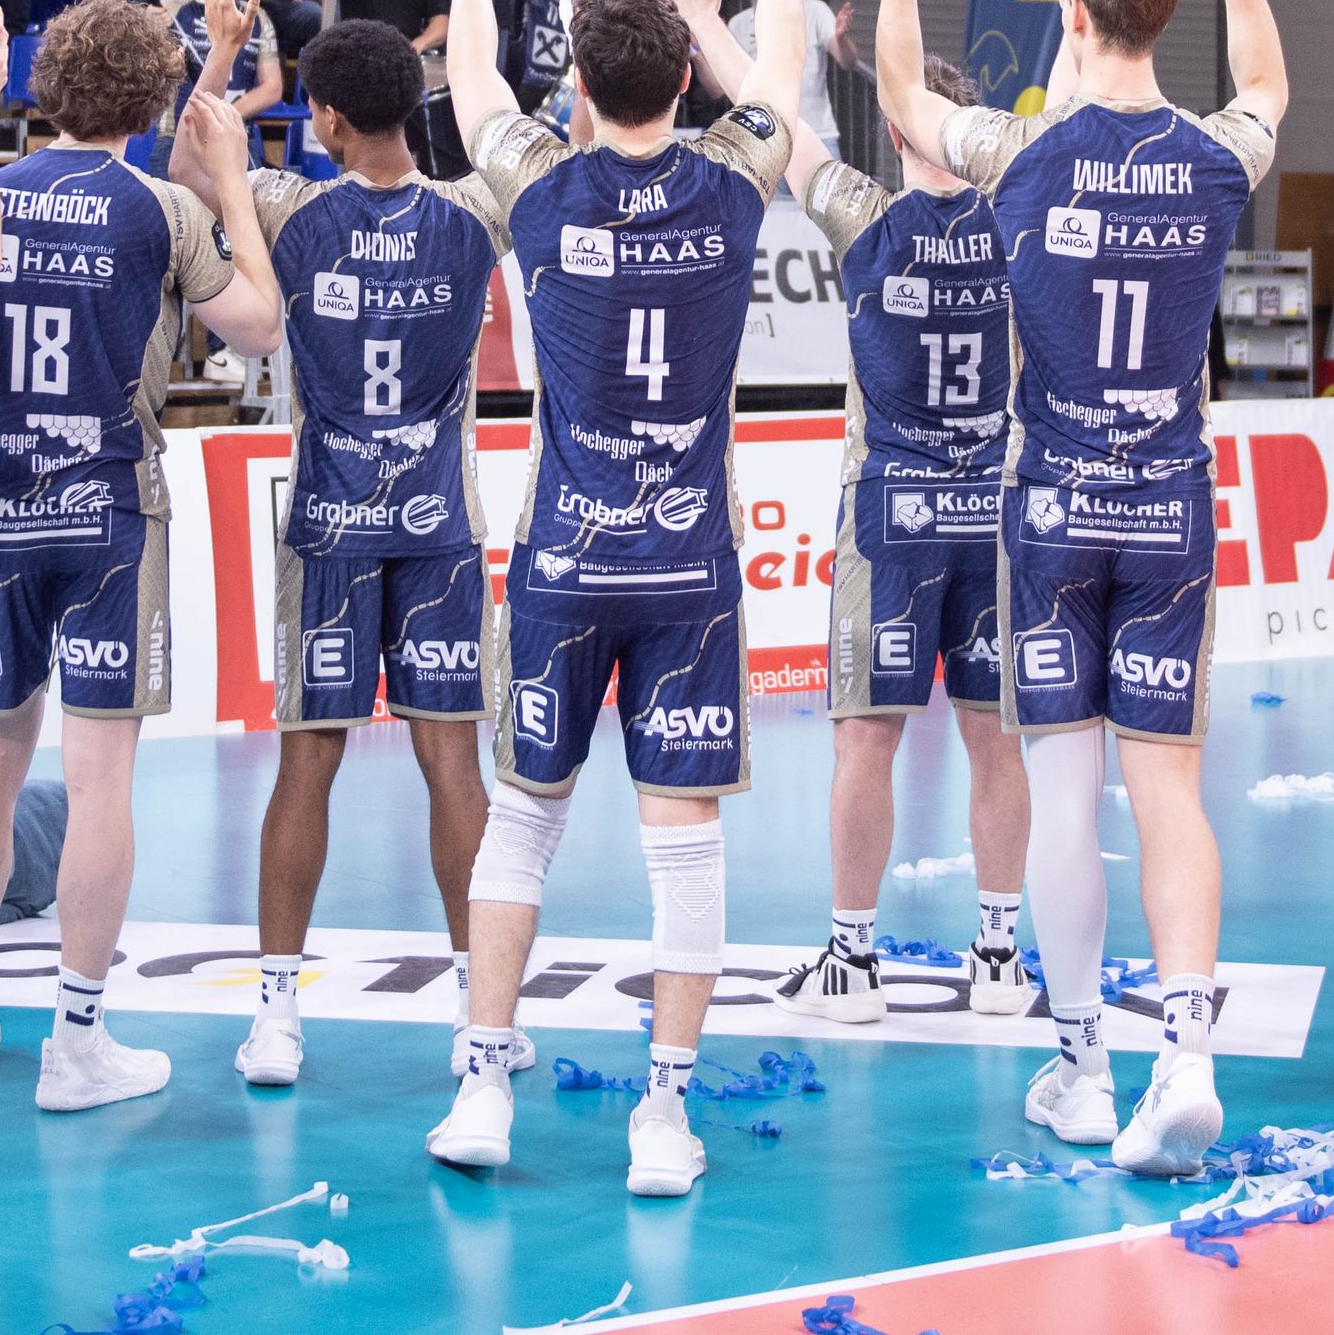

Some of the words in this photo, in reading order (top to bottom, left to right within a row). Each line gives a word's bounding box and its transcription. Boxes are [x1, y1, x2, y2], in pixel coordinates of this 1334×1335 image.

[1073, 158, 1193, 195] WILLIMEK
[618, 183, 669, 214] LARA
[619, 223, 723, 242] GeneralAgentur
[1107, 212, 1208, 226] GeneralAgentur
[24, 238, 116, 256] GeneralAgentur
[351, 230, 418, 262] DIONIS
[619, 234, 726, 263] HAAS
[912, 232, 993, 265] THALLER
[1050, 234, 1093, 250] UNIQA
[1104, 224, 1207, 247] HAAS
[22, 250, 115, 278] HAAS
[565, 253, 610, 269] UNIQA
[363, 283, 453, 309] HAAS
[364, 274, 452, 289] GeneralAgentur
[934, 282, 1011, 306] HAAS
[317, 298, 355, 314] UNIQA
[886, 297, 925, 312] UNIQA
[1092, 278, 1150, 370] 11
[4, 302, 72, 396] 18
[625, 307, 670, 402] 4
[363, 339, 402, 415] 8
[919, 332, 983, 407] 13
[71, 514, 104, 525] m.b.H.
[306, 494, 399, 527] Grabner
[1067, 515, 1146, 529] Baugesellschaft
[1149, 520, 1184, 530] m.b.H.
[400, 639, 480, 670] ASVÖ
[838, 617, 853, 674] nine
[1023, 638, 1066, 680] E
[65, 664, 128, 680] Steiermark
[147, 631, 163, 691] nine
[1110, 648, 1191, 689] ASVÖ
[1120, 680, 1188, 701] Steiermark
[644, 704, 734, 739] ASVÖ
[660, 737, 734, 752] Steiermark
[1189, 988, 1204, 1021] nine
